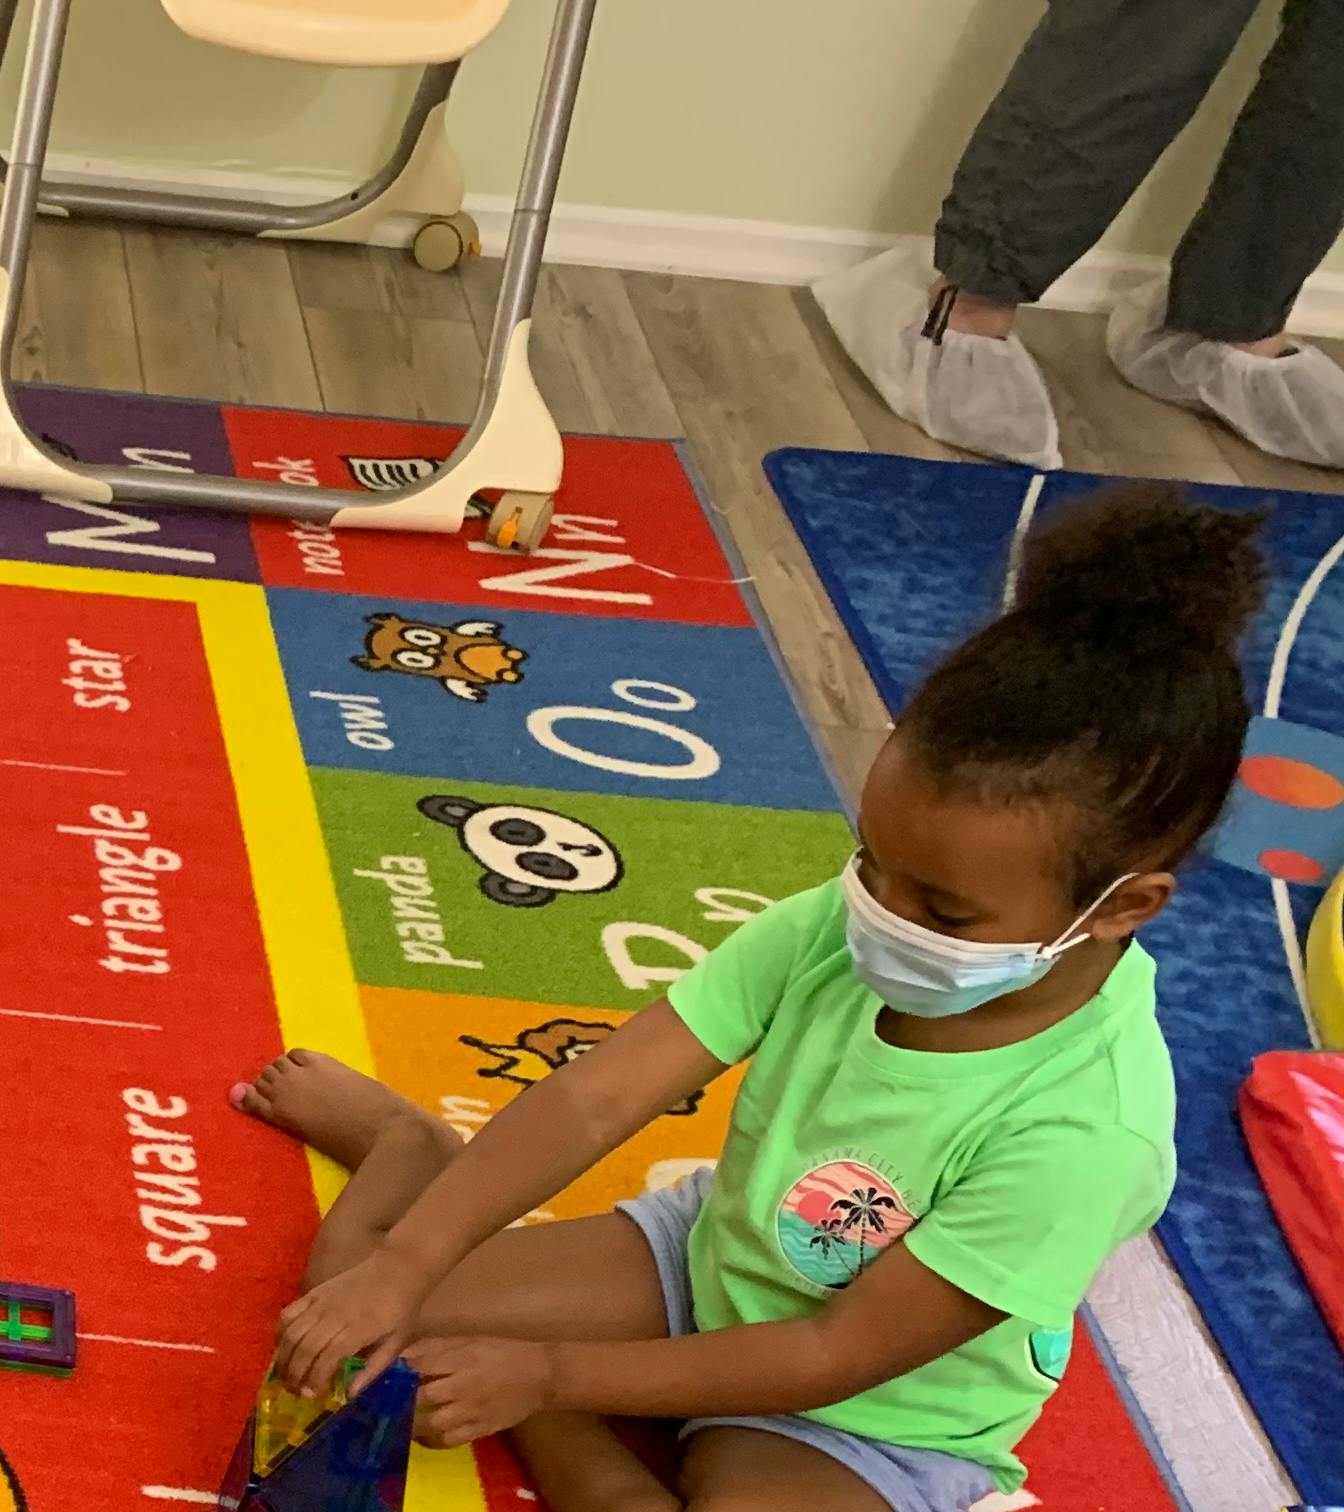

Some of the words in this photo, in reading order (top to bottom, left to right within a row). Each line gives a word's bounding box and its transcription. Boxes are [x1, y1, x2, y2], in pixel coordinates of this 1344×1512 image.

[252, 456, 346, 576] notok
[466, 513, 653, 605] Nn
[63, 639, 130, 711] star
[309, 691, 394, 750] owl
[527, 679, 720, 779] Oo
[57, 804, 181, 973] triangle
[353, 855, 484, 970] panda
[123, 1083, 247, 1270] square
[867, 1152, 905, 1184] CITY
